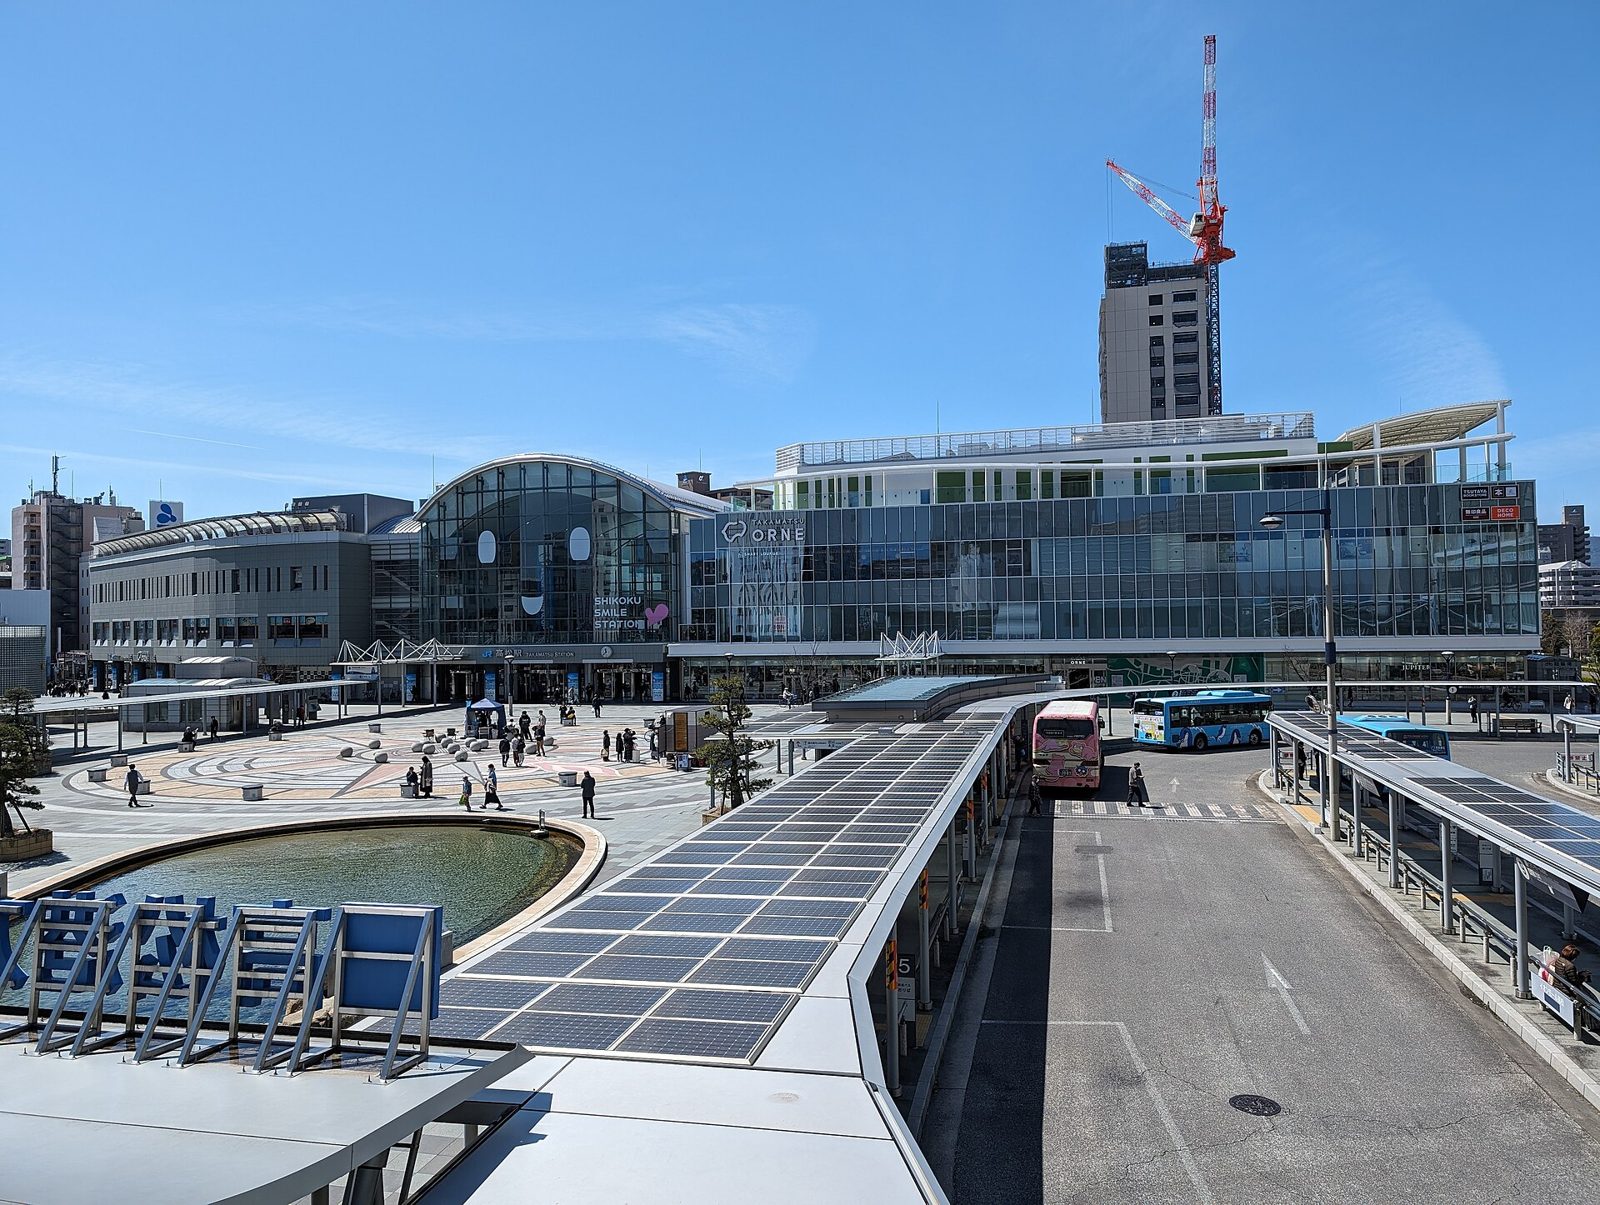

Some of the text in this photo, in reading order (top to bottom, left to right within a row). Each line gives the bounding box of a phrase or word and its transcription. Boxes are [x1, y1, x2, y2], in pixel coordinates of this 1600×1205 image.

[752, 528, 804, 542] ORNE
[594, 596, 641, 605] SHIKOKU
[594, 608, 627, 617] SMILE
[594, 620, 642, 629] STATION
[898, 958, 910, 974] 5
